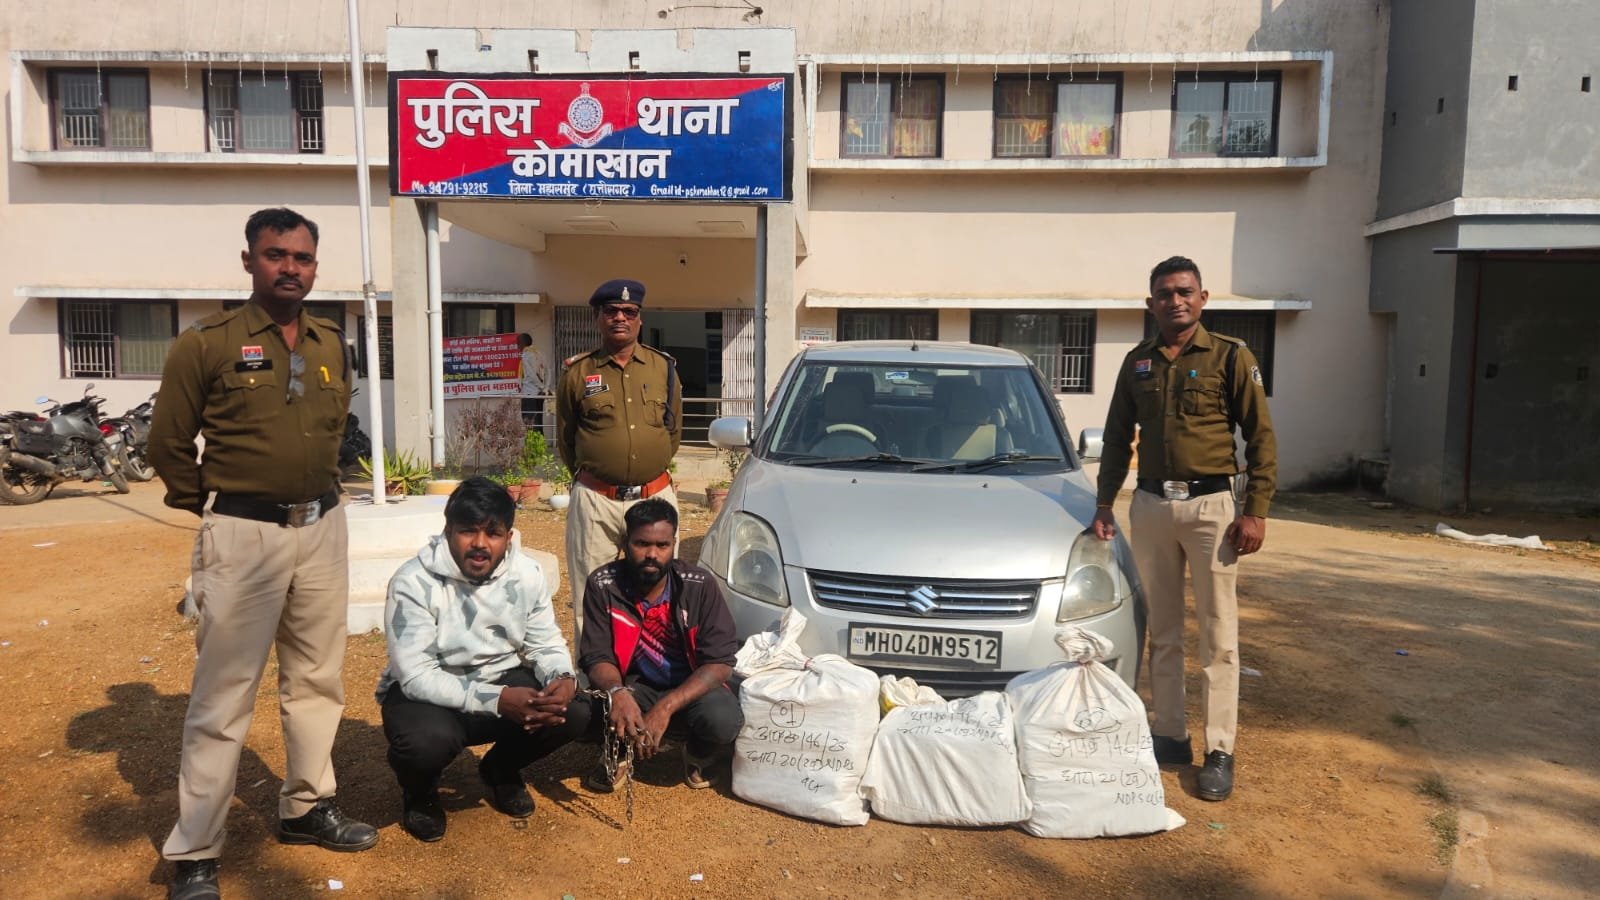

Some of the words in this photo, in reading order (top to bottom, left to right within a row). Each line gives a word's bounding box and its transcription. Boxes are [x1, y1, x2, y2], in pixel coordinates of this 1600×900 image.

[408, 81, 540, 148] पुलिस
[638, 97, 739, 136] थाना
[507, 140, 671, 179] कोमाखान
[452, 383, 475, 395] पुलिस
[864, 631, 998, 660] MH04DN9512
